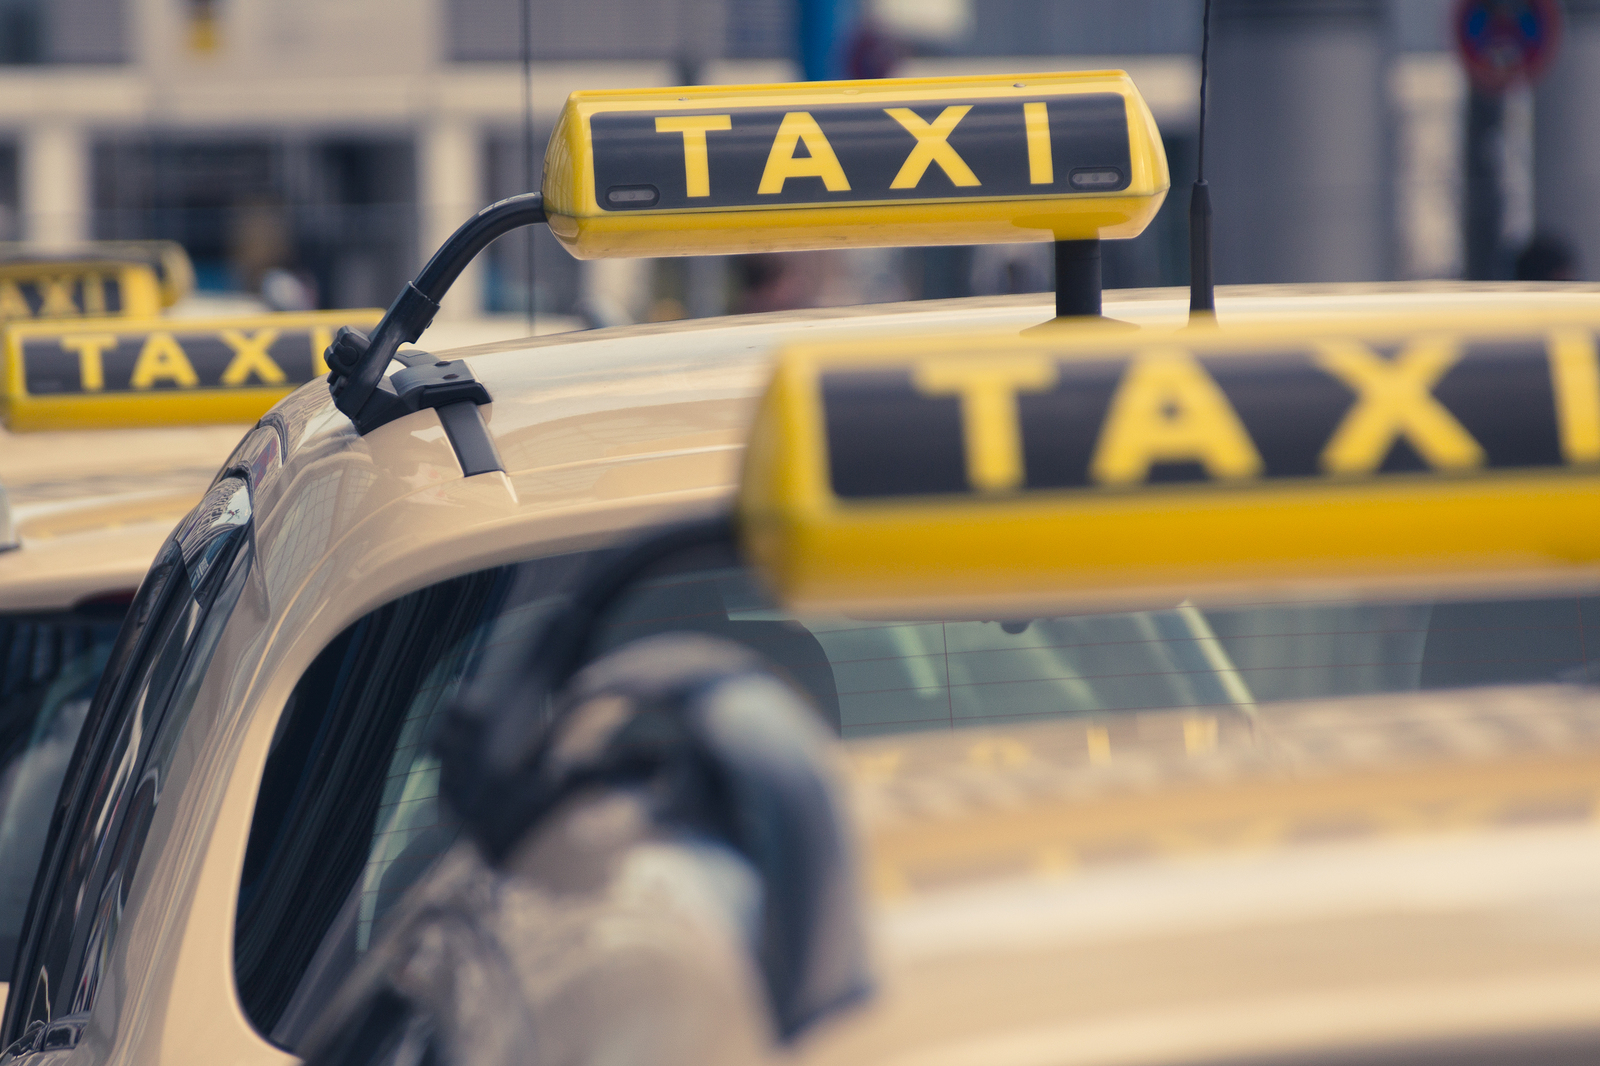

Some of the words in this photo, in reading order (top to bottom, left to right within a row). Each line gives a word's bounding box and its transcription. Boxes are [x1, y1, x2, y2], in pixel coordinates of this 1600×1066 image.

[655, 102, 1054, 198] TAXI
[60, 325, 334, 391] TAXI
[910, 328, 1600, 490] TAXI
